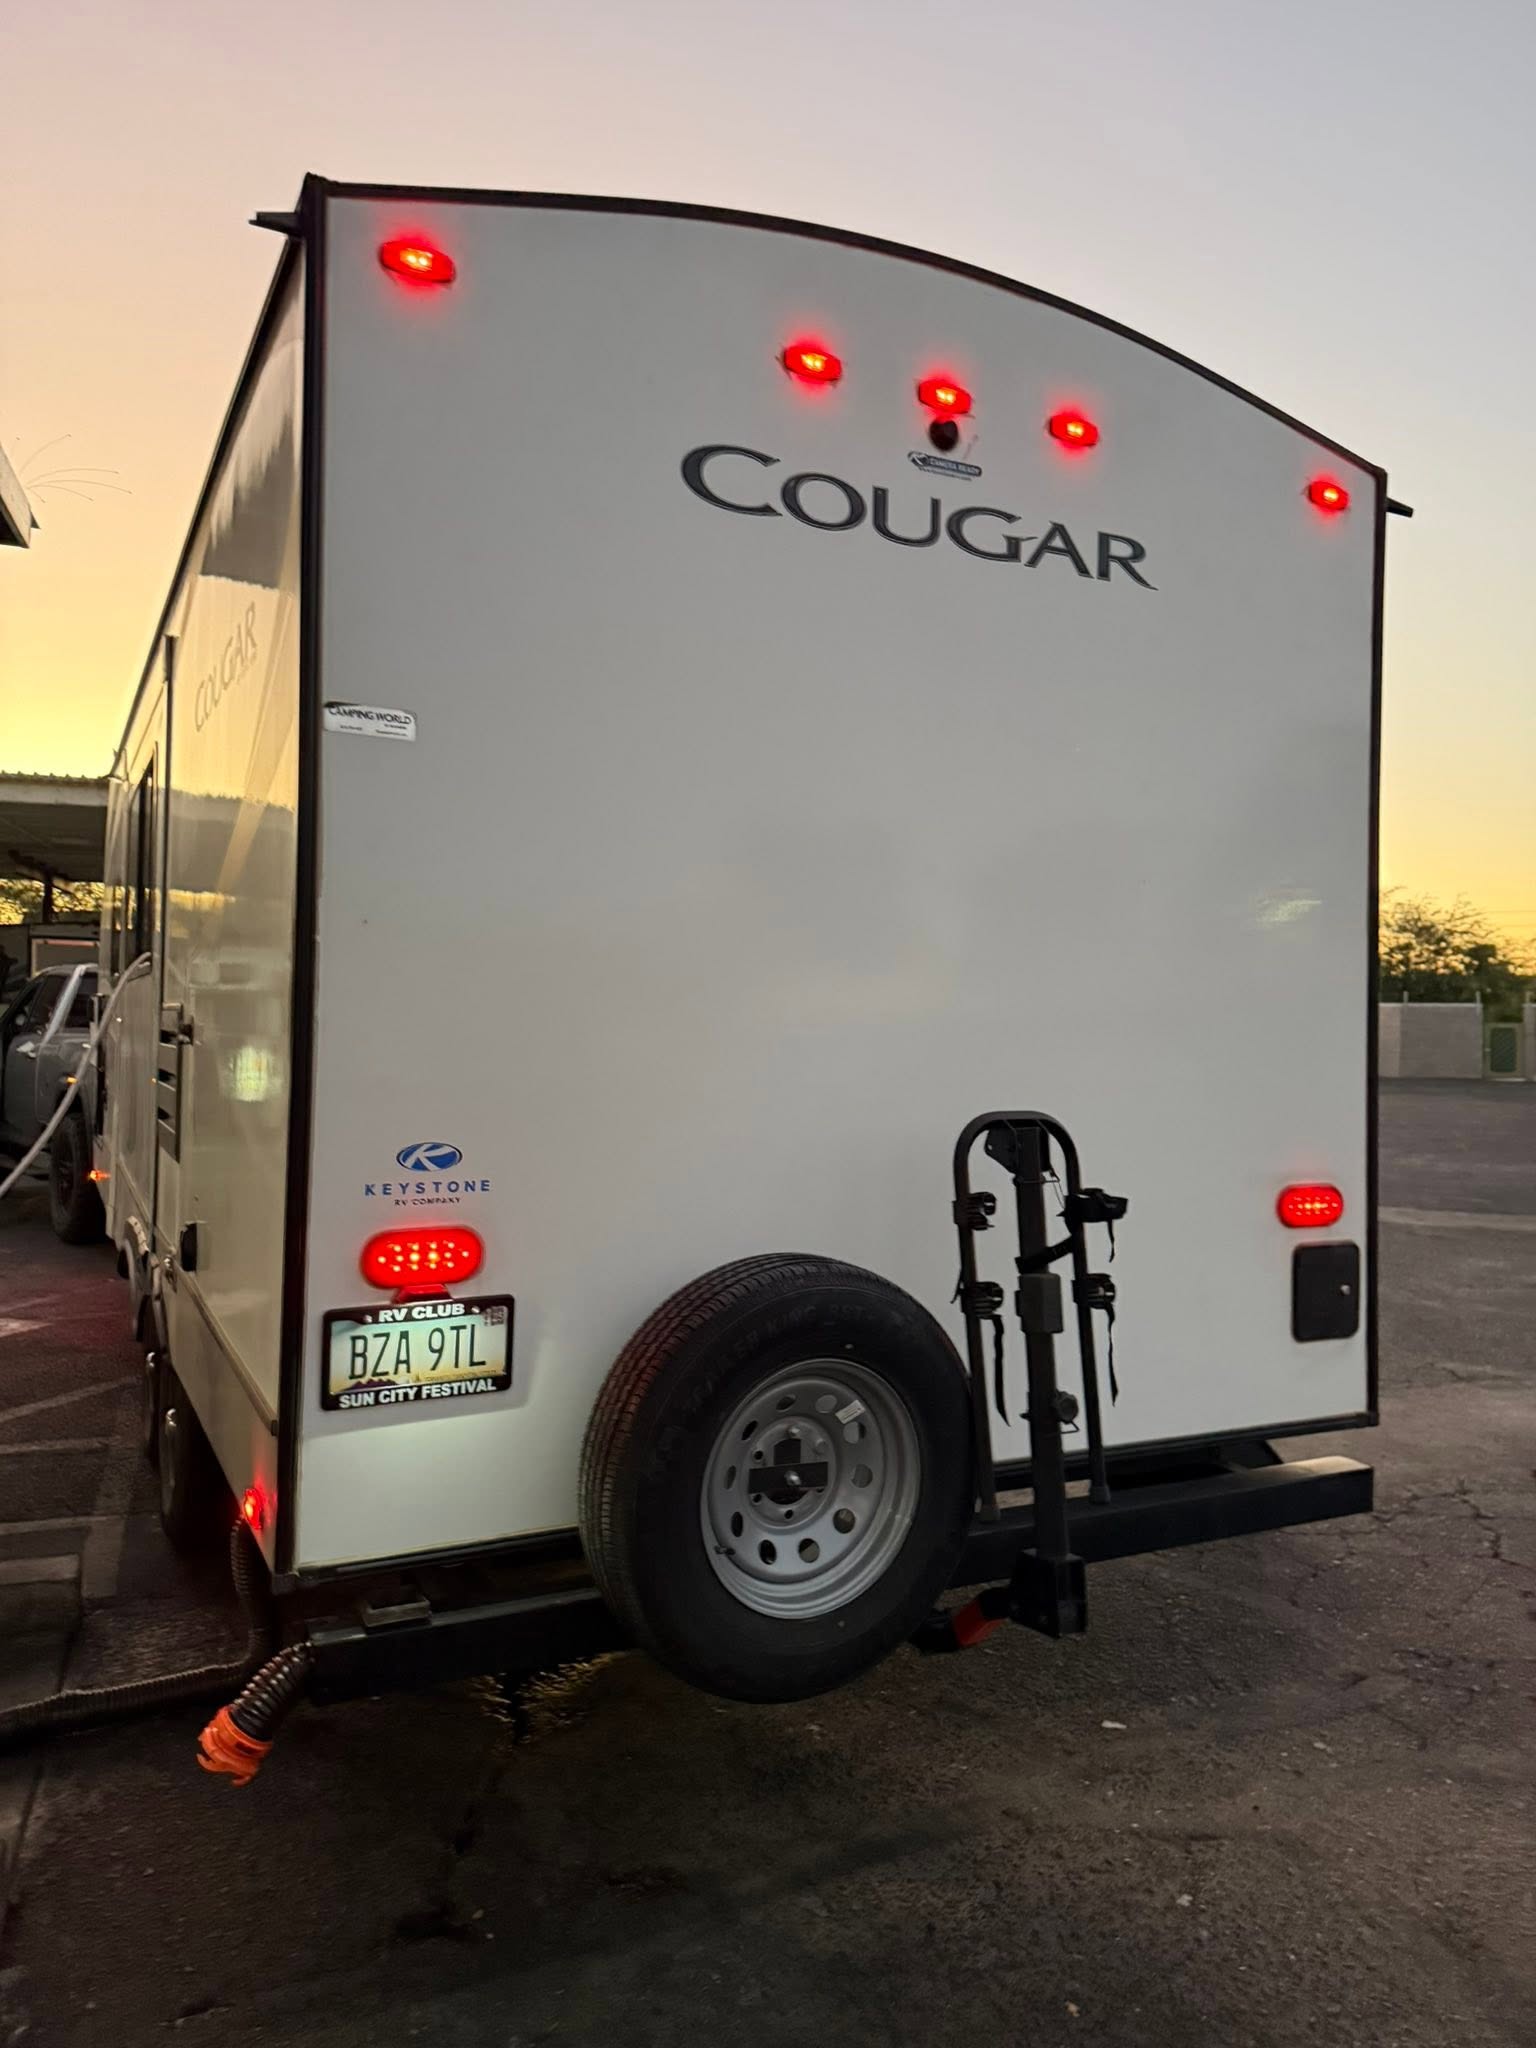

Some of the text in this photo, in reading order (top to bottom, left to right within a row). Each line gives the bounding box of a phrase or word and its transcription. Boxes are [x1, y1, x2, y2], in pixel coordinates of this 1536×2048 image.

[681, 444, 1159, 590] COUGAR
[194, 601, 257, 732] COUGAR
[376, 712, 412, 725] WORLD
[364, 1180, 490, 1196] KEYSTONE
[412, 1197, 461, 1206] COMPANY
[379, 1307, 408, 1323] RV
[412, 1303, 465, 1320] CLUB
[349, 1324, 487, 1380] BZA 9TL
[339, 1378, 497, 1408] SUN CITY FESTIVAL
